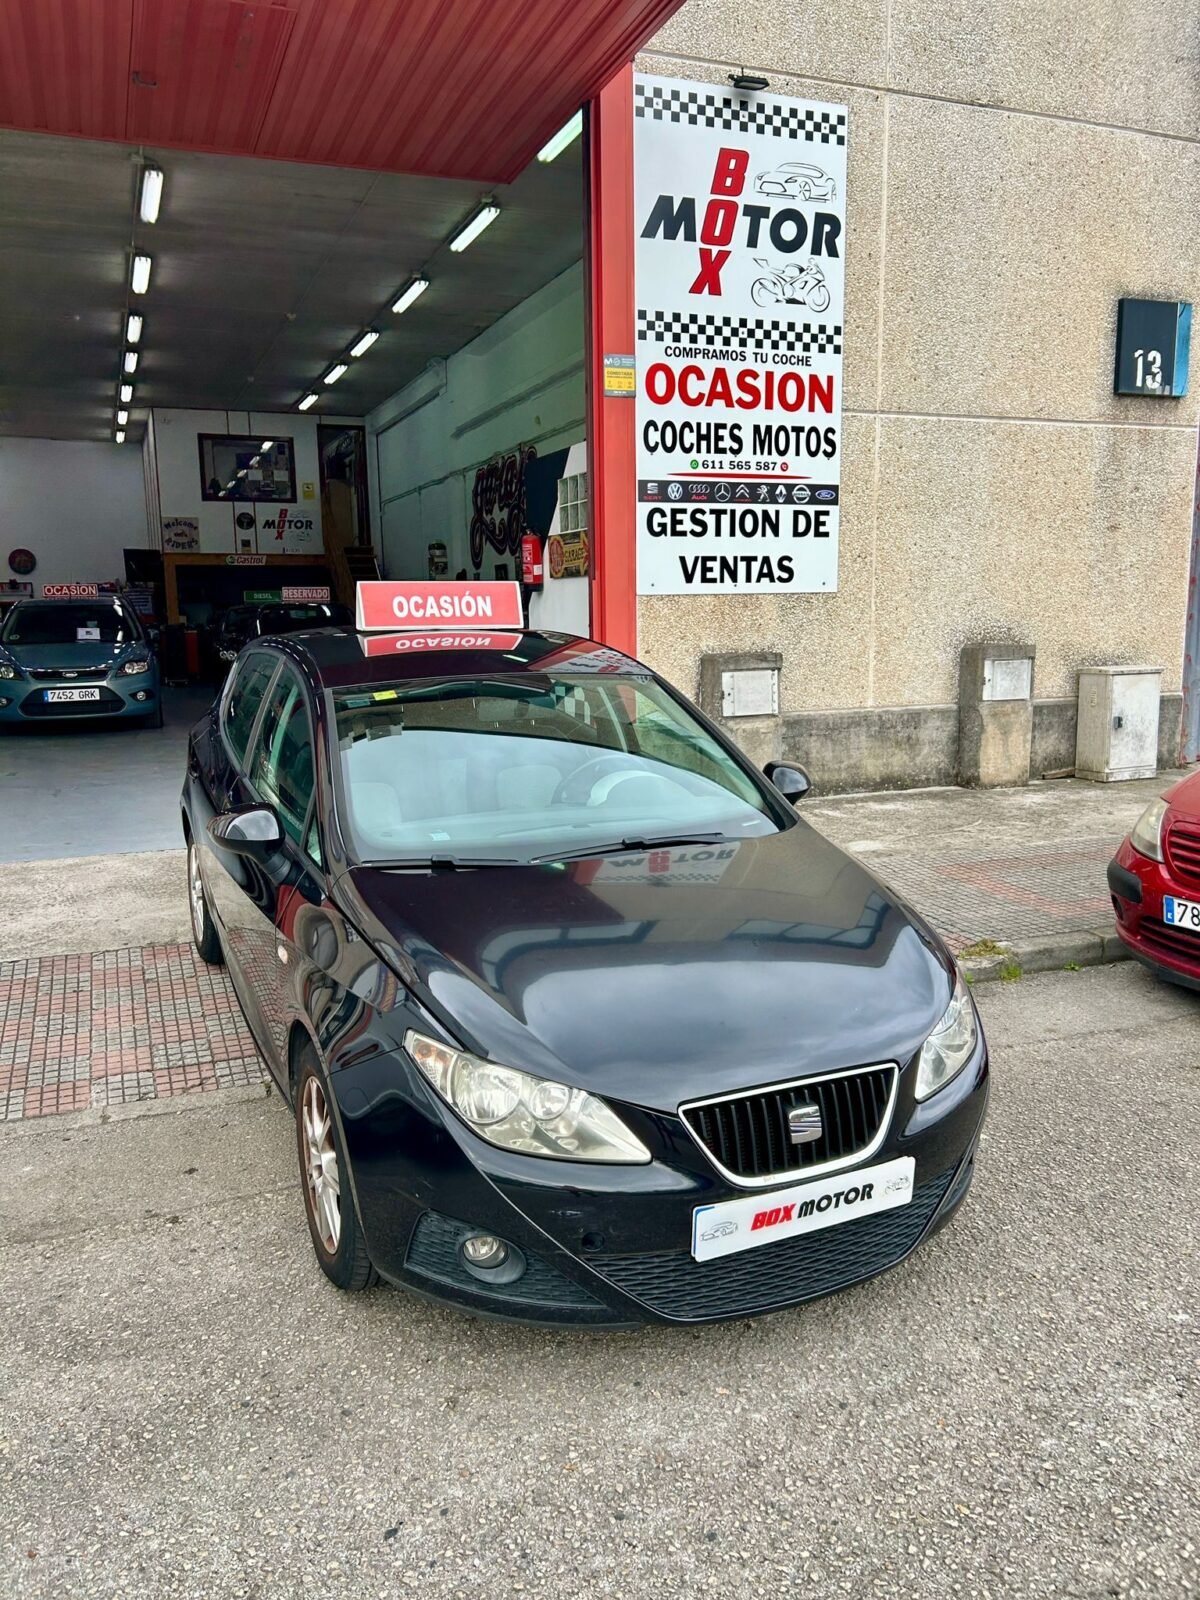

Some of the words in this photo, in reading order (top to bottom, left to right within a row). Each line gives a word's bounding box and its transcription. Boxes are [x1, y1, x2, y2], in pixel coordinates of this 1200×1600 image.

[640, 194, 842, 259] MOTOR
[689, 147, 750, 296] BOX
[664, 346, 747, 361] COMPRAMOS
[752, 353, 769, 364] TU
[772, 354, 812, 367] COCHE
[1134, 349, 1162, 389] 13
[645, 362, 834, 414] OCASION
[643, 419, 744, 456] COCHES
[752, 424, 837, 458] MOTOS
[702, 460, 724, 470] 611
[728, 460, 752, 470] 565
[755, 461, 777, 471] 587
[262, 519, 313, 530] MOTOR
[646, 507, 780, 538] GESTION
[792, 509, 830, 538] DE
[236, 556, 264, 565] Castrol
[679, 555, 794, 584] VENTAS
[44, 585, 97, 596] OCASION
[283, 588, 329, 600] RESERVADO
[392, 590, 493, 618] OCASIÓN
[50, 689, 74, 700] 7452
[78, 688, 96, 699] GRK
[750, 1203, 797, 1231] BOX
[798, 1183, 874, 1218] MOTOR
